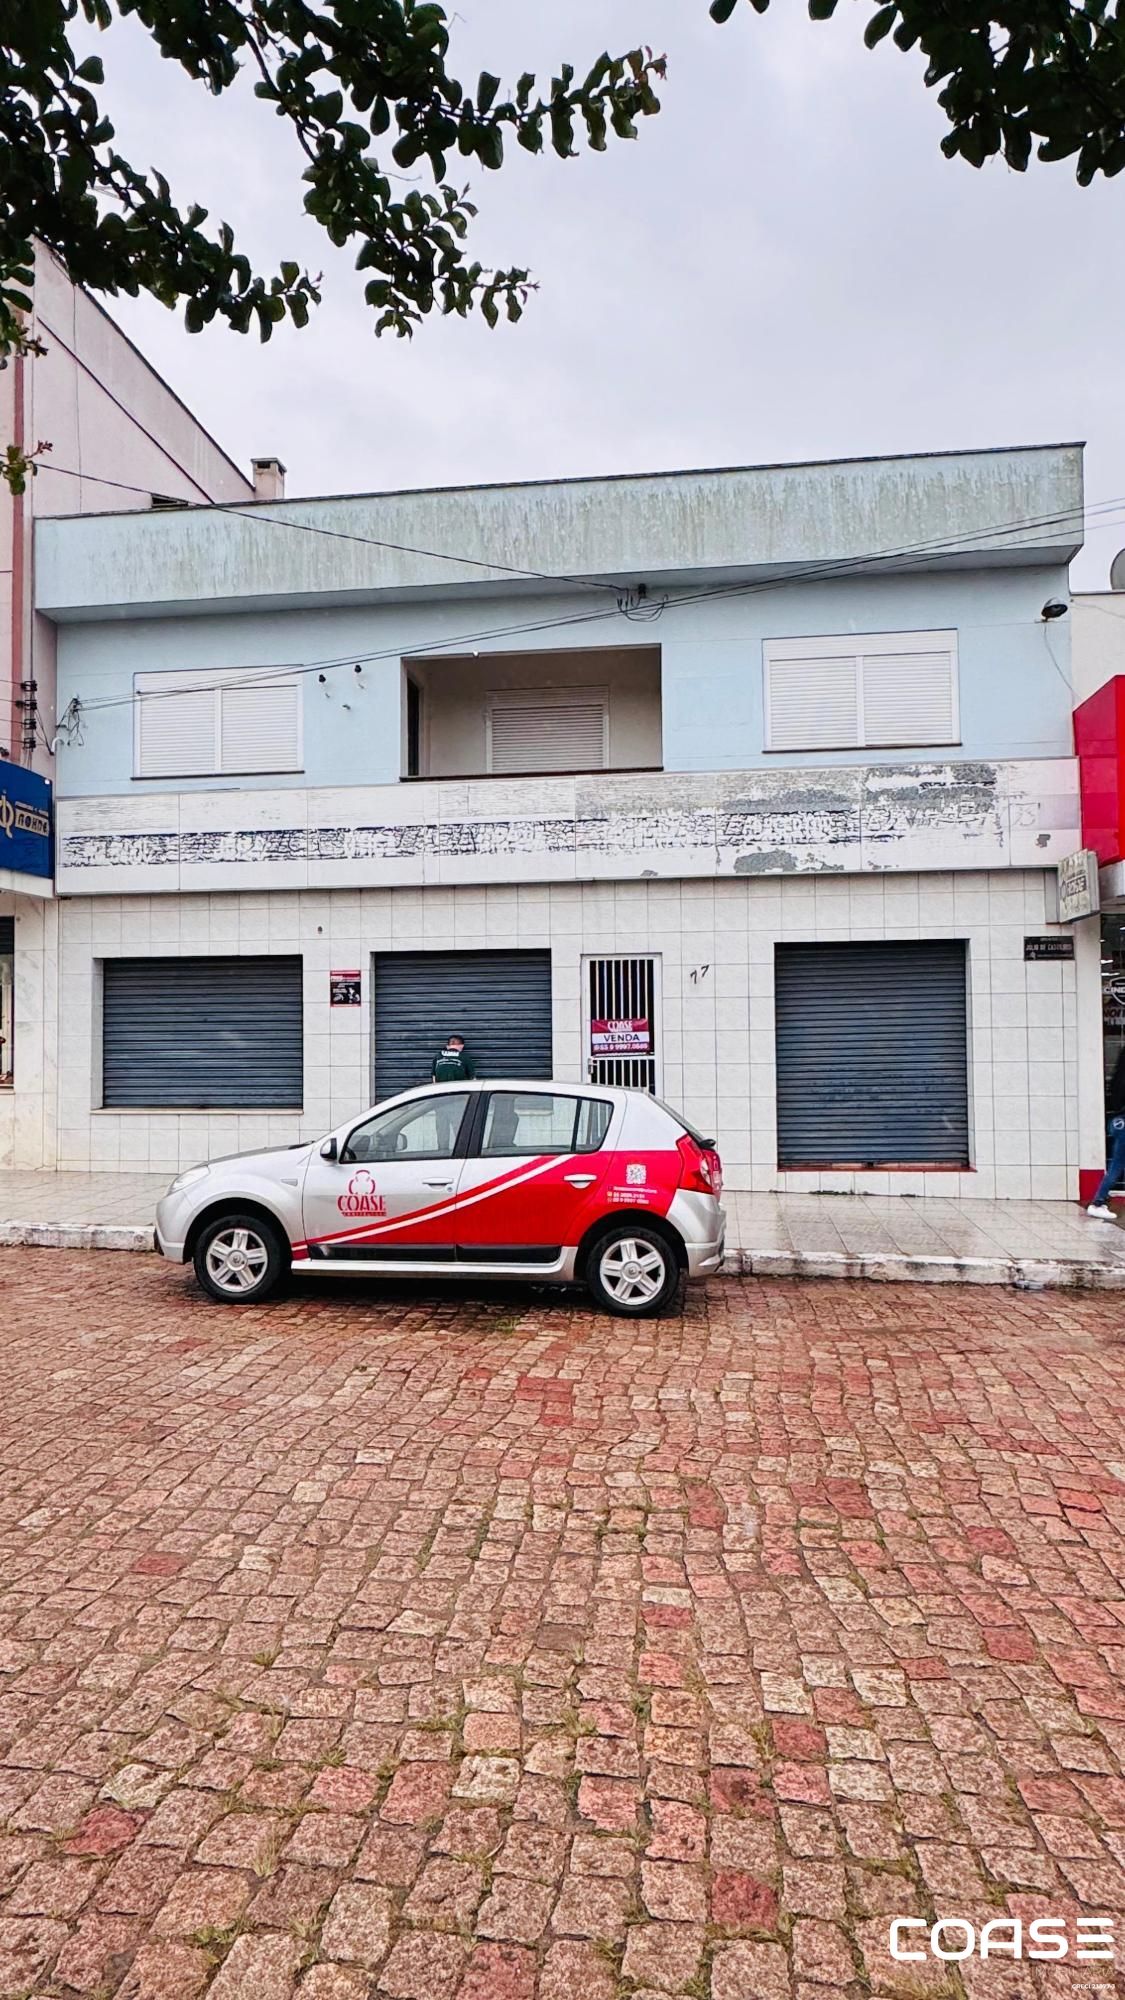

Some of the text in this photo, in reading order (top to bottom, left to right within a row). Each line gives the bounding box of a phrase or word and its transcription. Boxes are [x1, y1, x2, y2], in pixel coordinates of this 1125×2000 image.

[607, 1020, 633, 1032] COASE
[604, 1033, 640, 1042] VENDA
[337, 1195, 386, 1211] COASE
